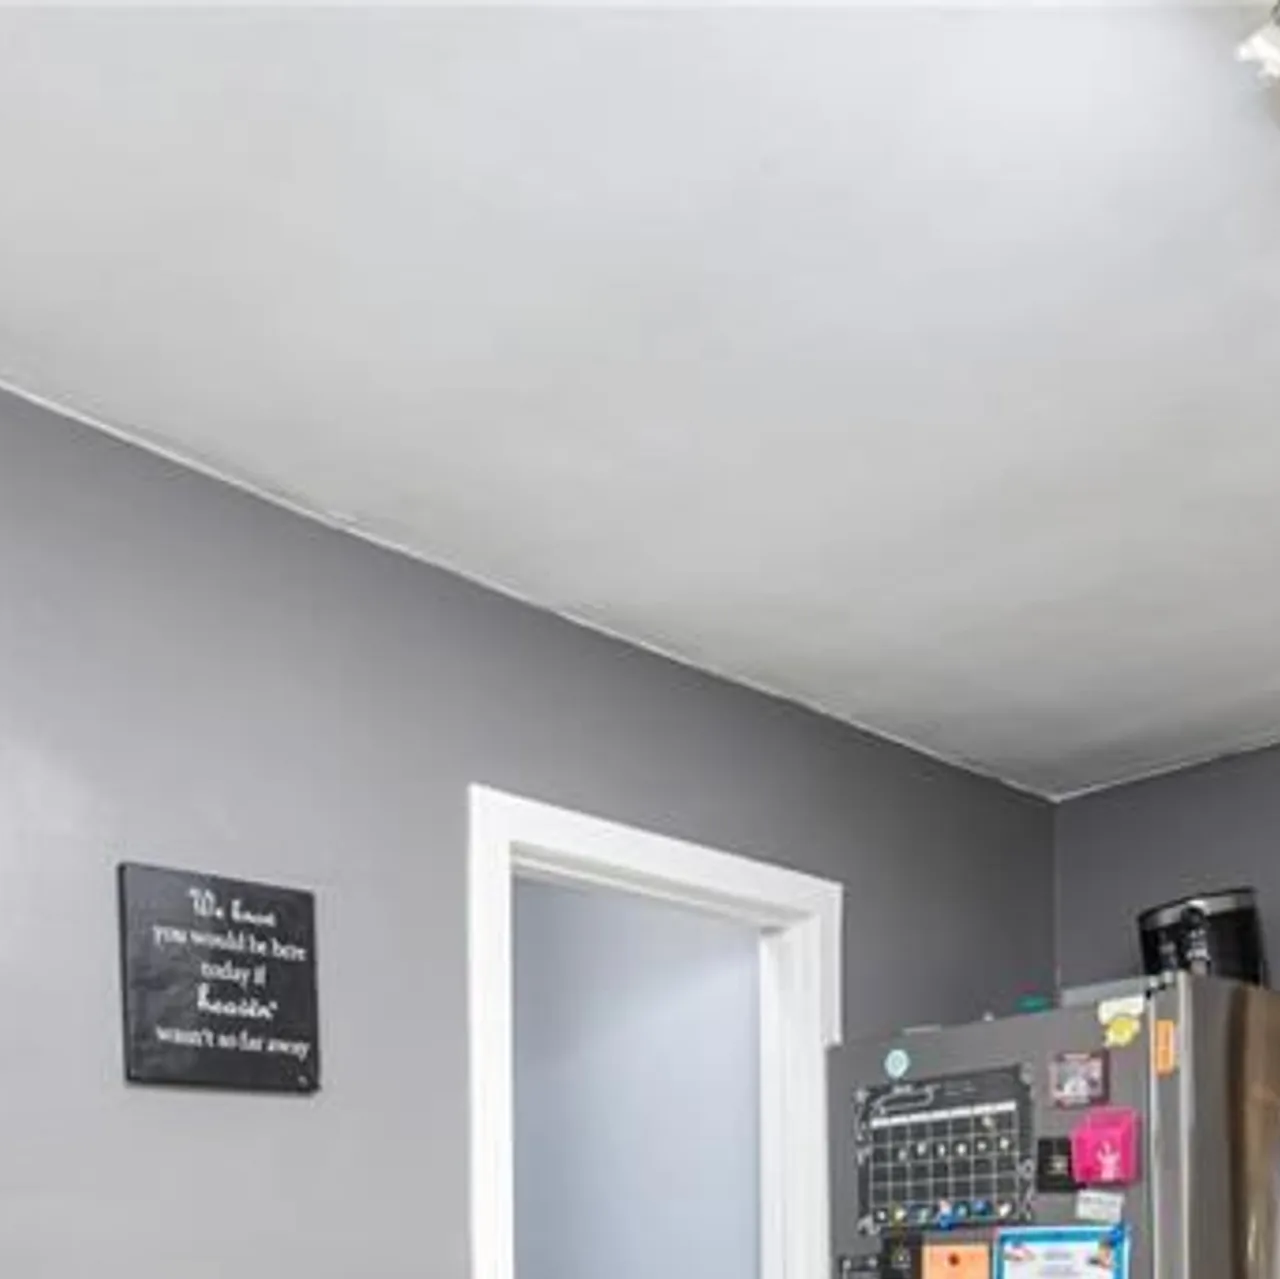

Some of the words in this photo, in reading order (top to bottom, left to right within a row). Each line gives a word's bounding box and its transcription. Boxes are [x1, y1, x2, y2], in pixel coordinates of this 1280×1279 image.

[189, 930, 245, 951] would
[249, 934, 267, 956] be
[272, 937, 306, 961] here
[201, 960, 250, 990] today
[267, 1037, 311, 1063] away
